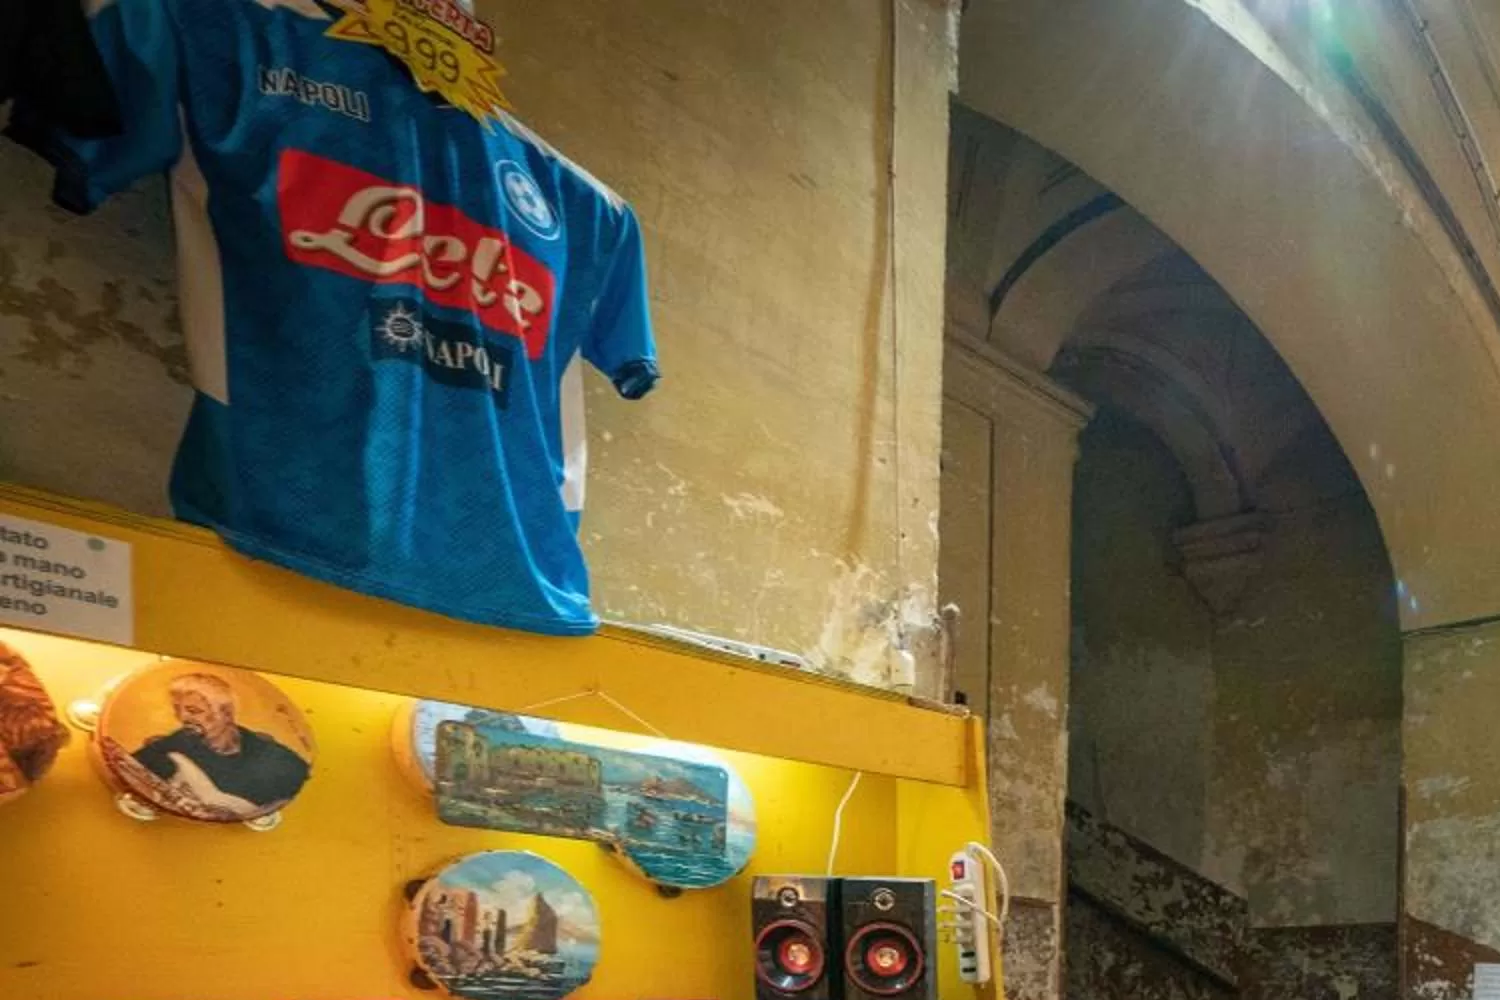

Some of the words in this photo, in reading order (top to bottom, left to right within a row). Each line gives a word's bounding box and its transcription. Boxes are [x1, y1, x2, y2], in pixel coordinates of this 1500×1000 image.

[258, 64, 369, 122] NAPOLI
[422, 330, 505, 391] NAPOI
[13, 554, 87, 579] mano
